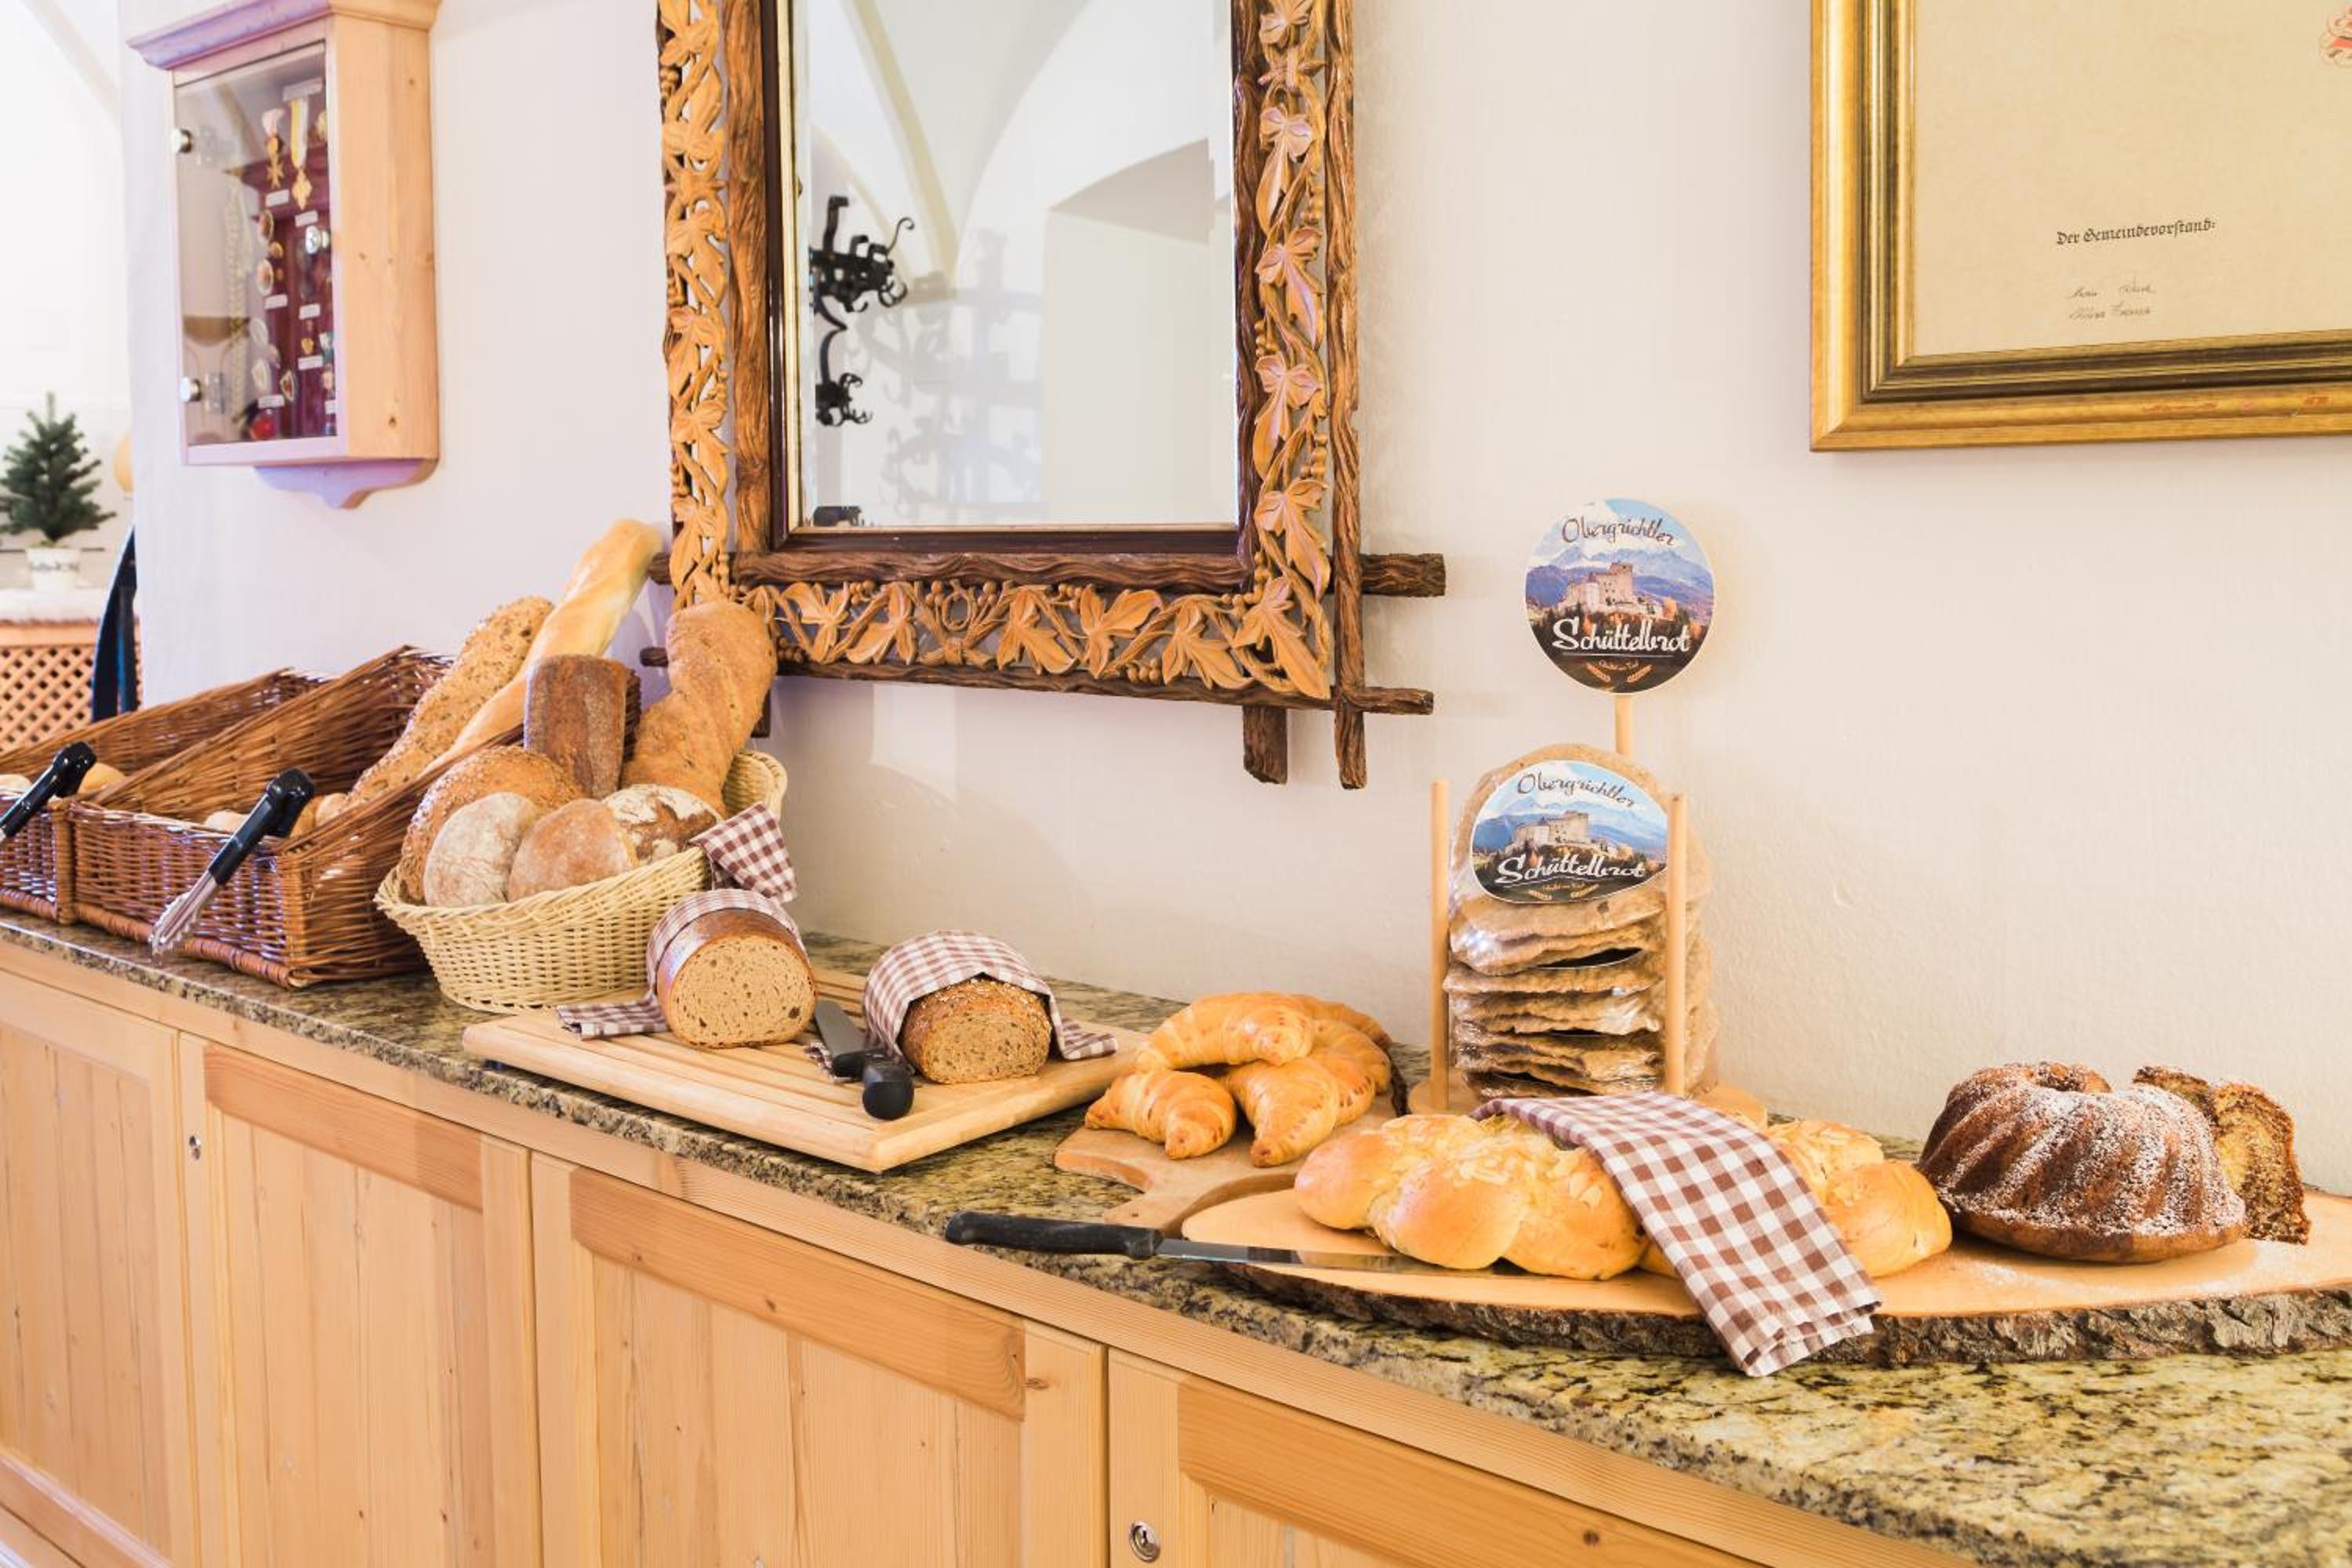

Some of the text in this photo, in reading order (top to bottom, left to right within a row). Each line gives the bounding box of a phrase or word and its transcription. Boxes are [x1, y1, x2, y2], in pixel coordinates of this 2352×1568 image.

[2056, 230, 2079, 245] Der
[1562, 514, 1675, 546] Obergrichtler
[1552, 616, 1691, 653] Schüttelbrot
[1517, 771, 1635, 808] Obergrichtler
[1494, 852, 1646, 884] Schüttelbrot
